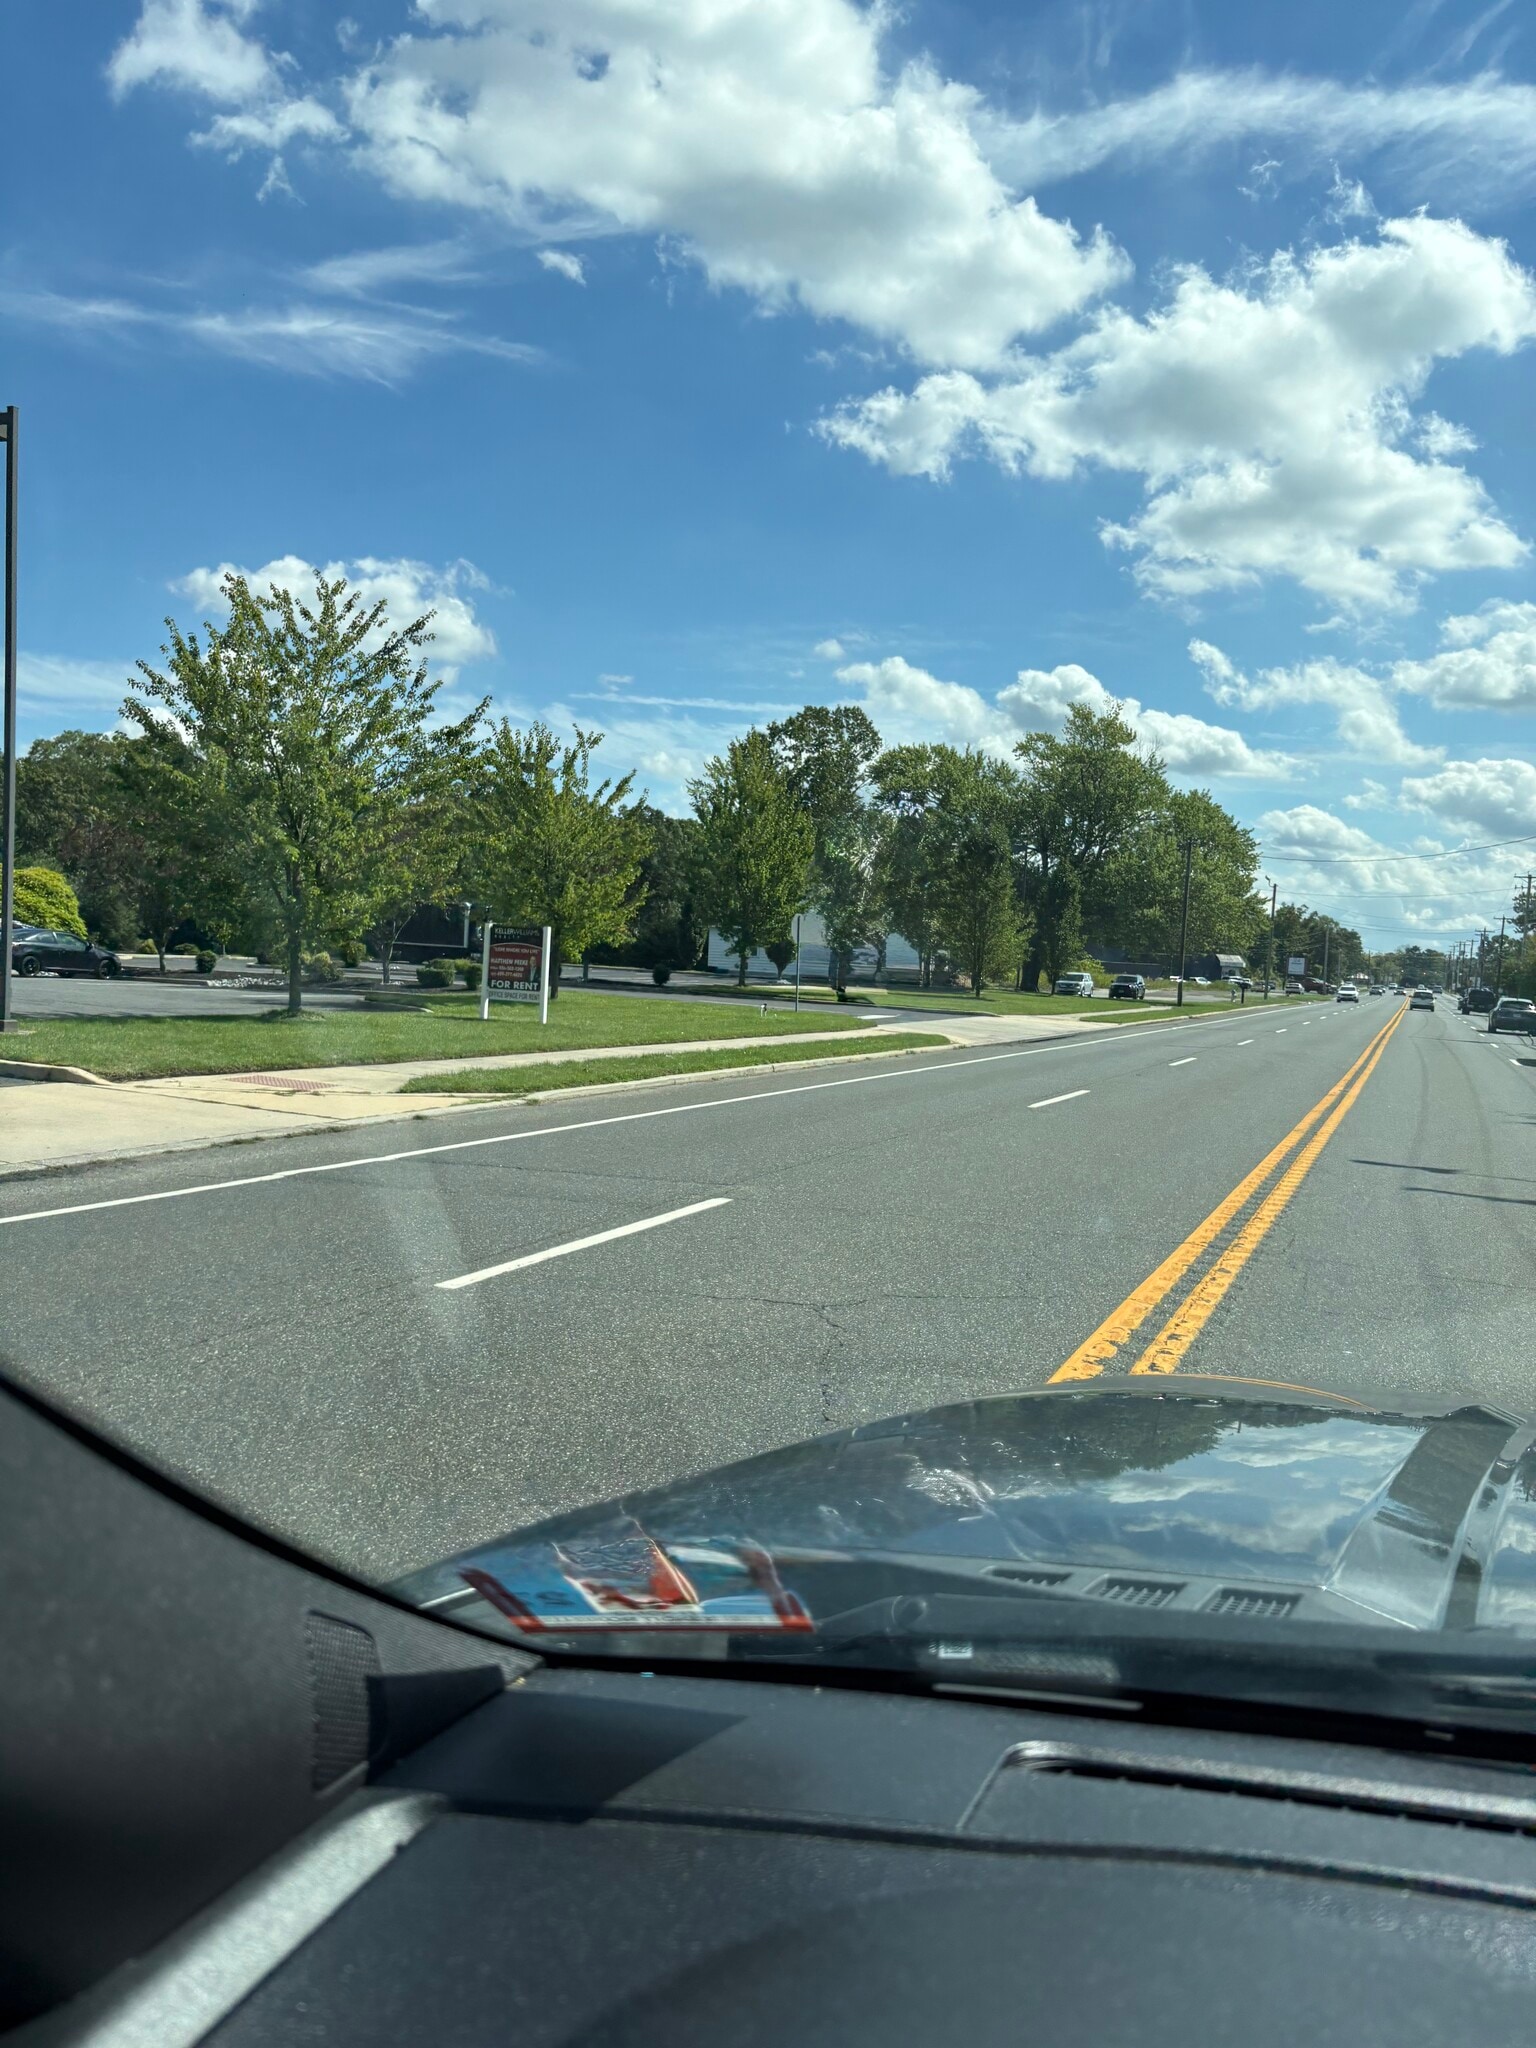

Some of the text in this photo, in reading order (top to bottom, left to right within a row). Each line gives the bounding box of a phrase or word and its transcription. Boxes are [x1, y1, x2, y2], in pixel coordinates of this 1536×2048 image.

[491, 980, 539, 991] FOR RENT
[489, 990, 503, 998] OFFICE
[504, 991, 519, 999] SPACE
[528, 993, 541, 1001] RENT
